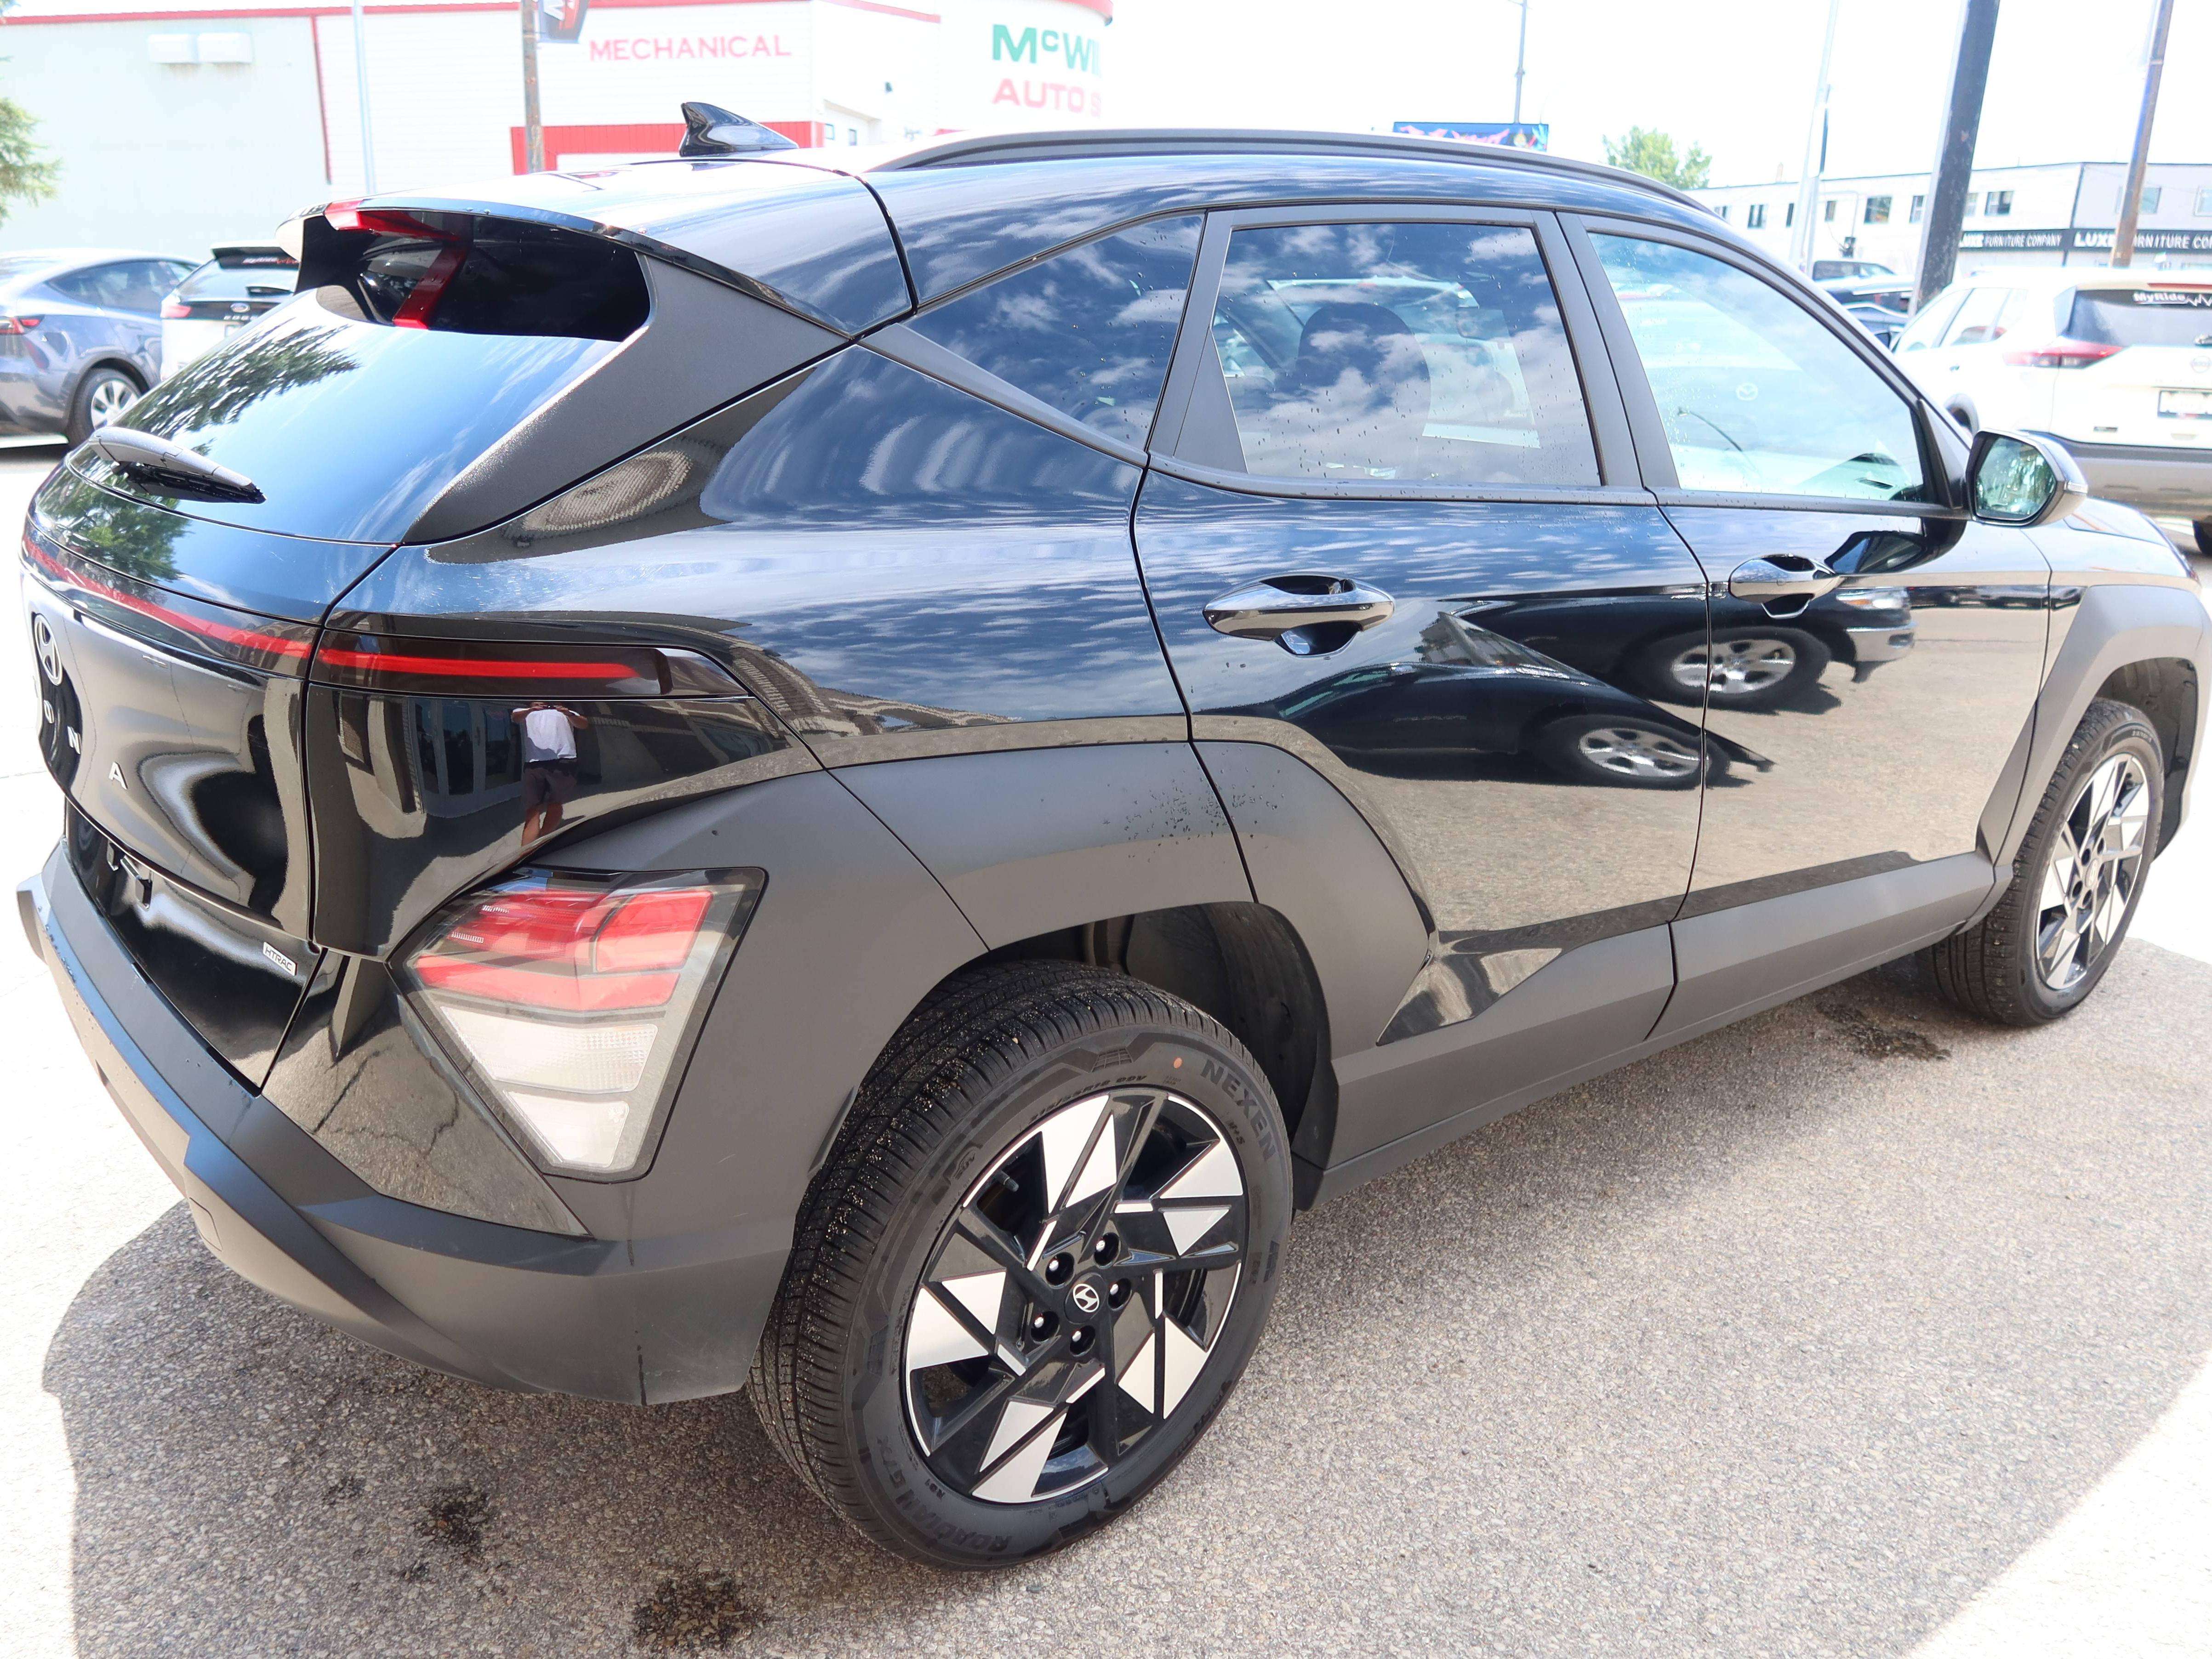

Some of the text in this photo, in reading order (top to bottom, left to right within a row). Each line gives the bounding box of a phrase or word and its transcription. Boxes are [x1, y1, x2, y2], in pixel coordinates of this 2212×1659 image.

[590, 34, 792, 62] MECHANICAL
[992, 78, 1084, 113] AUTO
[1985, 234, 2025, 247] FURNITURE
[2026, 233, 2062, 247] COMPANY
[265, 946, 293, 972] HTRAC
[1201, 1059, 1276, 1161] NEXEN
